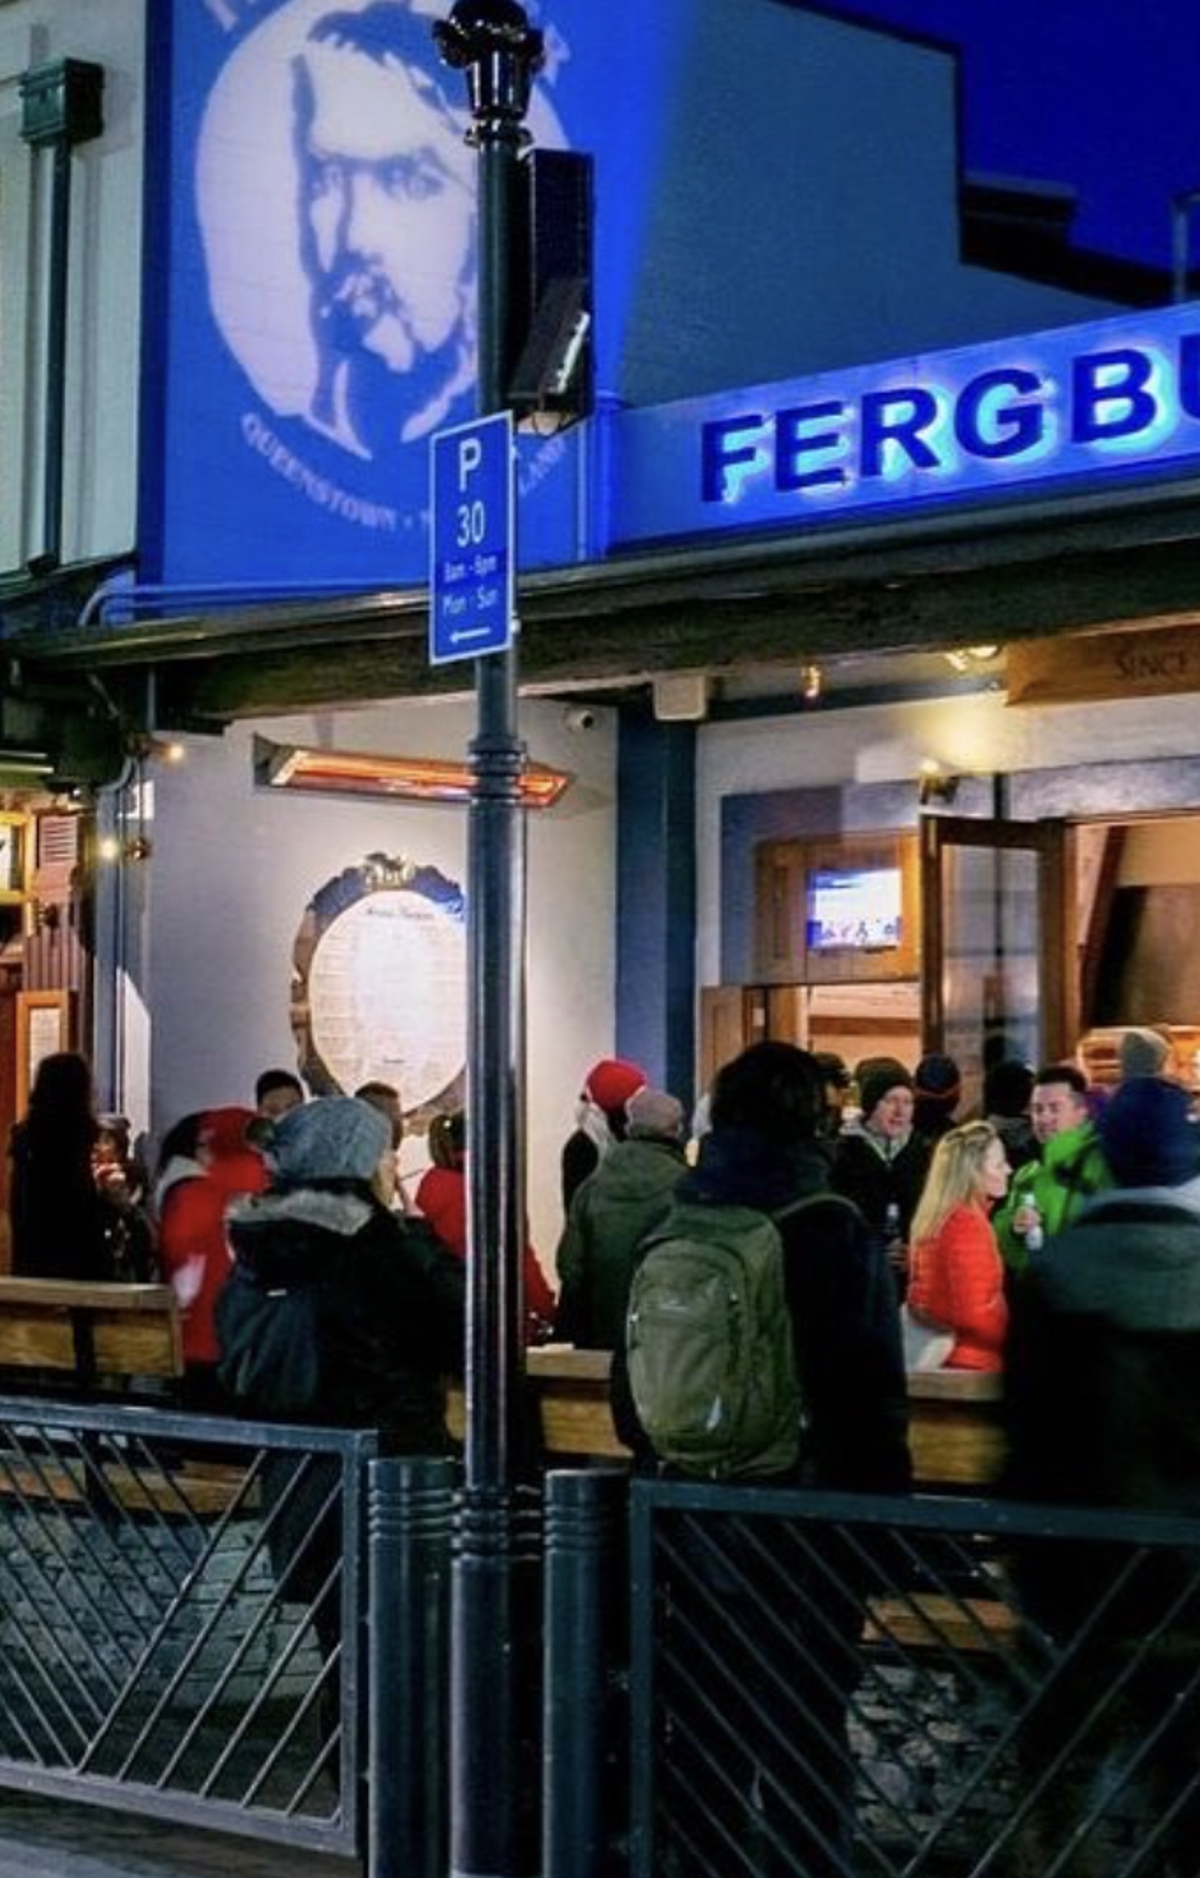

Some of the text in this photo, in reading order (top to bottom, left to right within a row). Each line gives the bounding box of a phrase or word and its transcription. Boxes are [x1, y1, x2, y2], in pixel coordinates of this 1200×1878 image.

[241, 412, 398, 531] QUEENSTOWN
[460, 438, 482, 492] P
[457, 501, 486, 547] 30
